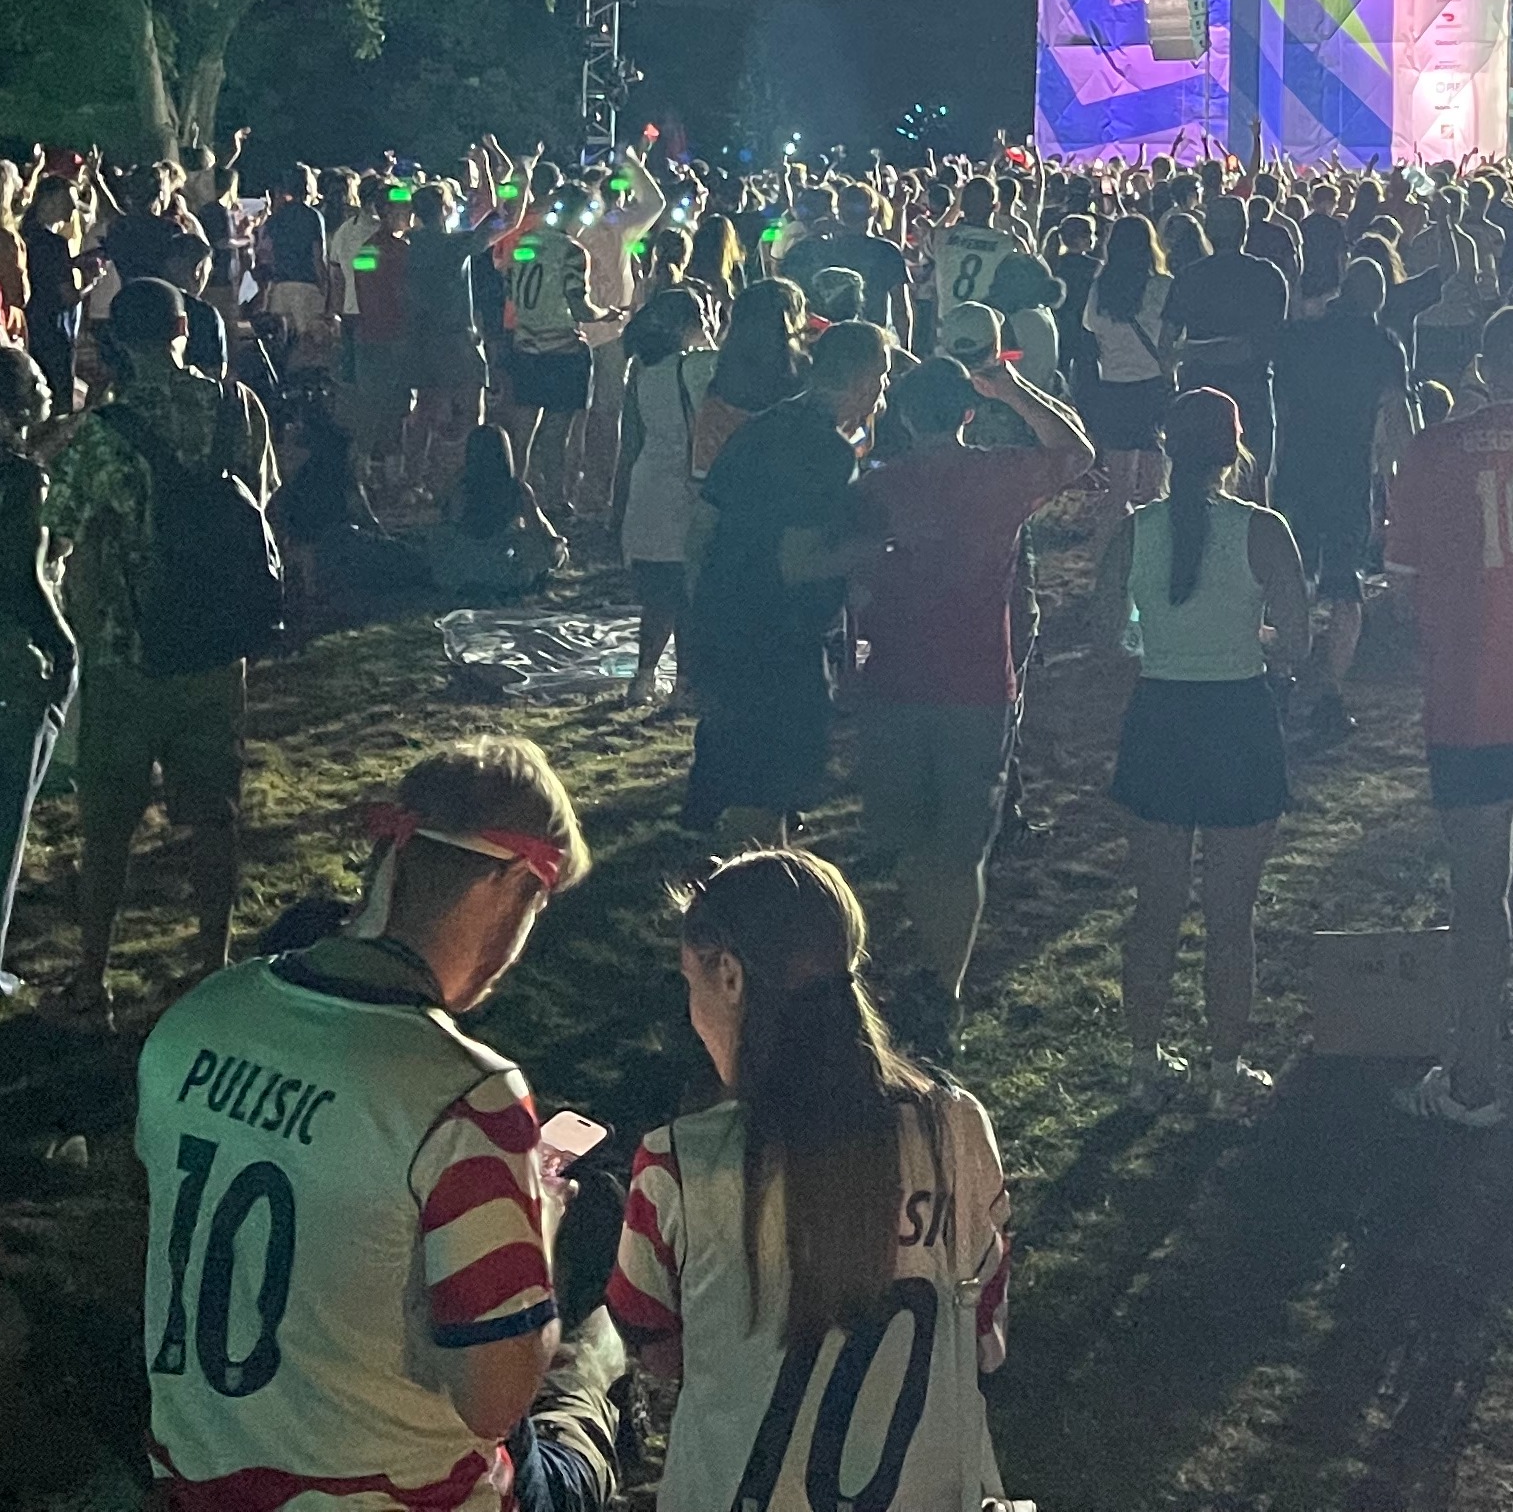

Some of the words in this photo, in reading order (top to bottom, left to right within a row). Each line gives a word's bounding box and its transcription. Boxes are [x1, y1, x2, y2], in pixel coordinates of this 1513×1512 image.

[952, 252, 983, 300] 8
[178, 1048, 337, 1147] PULISIC
[149, 1132, 297, 1398] 10
